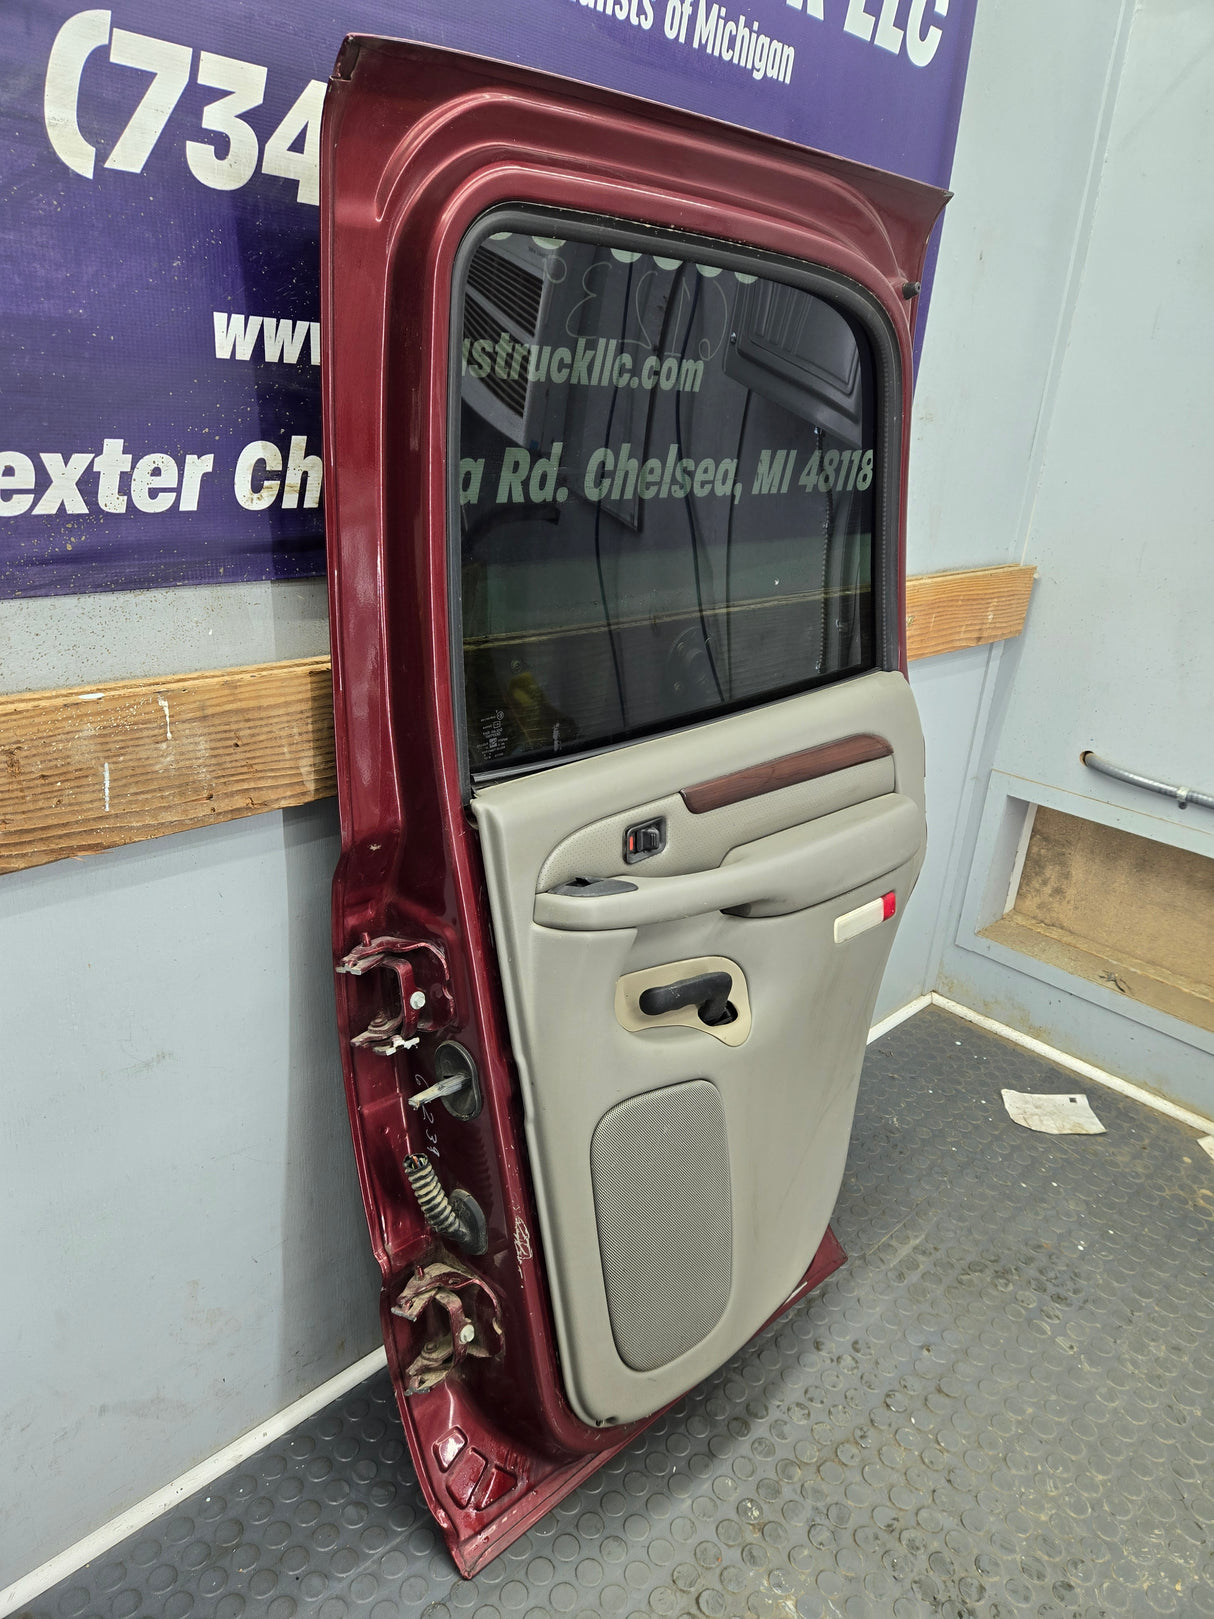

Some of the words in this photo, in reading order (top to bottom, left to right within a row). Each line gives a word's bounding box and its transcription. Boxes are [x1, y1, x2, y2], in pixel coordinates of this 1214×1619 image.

[664, 0, 694, 44] of
[693, 3, 795, 84] Michigan
[496, 441, 568, 504] Rd.
[584, 442, 743, 505] Chelsea,
[751, 449, 798, 495] MI
[799, 448, 875, 493] 48118
